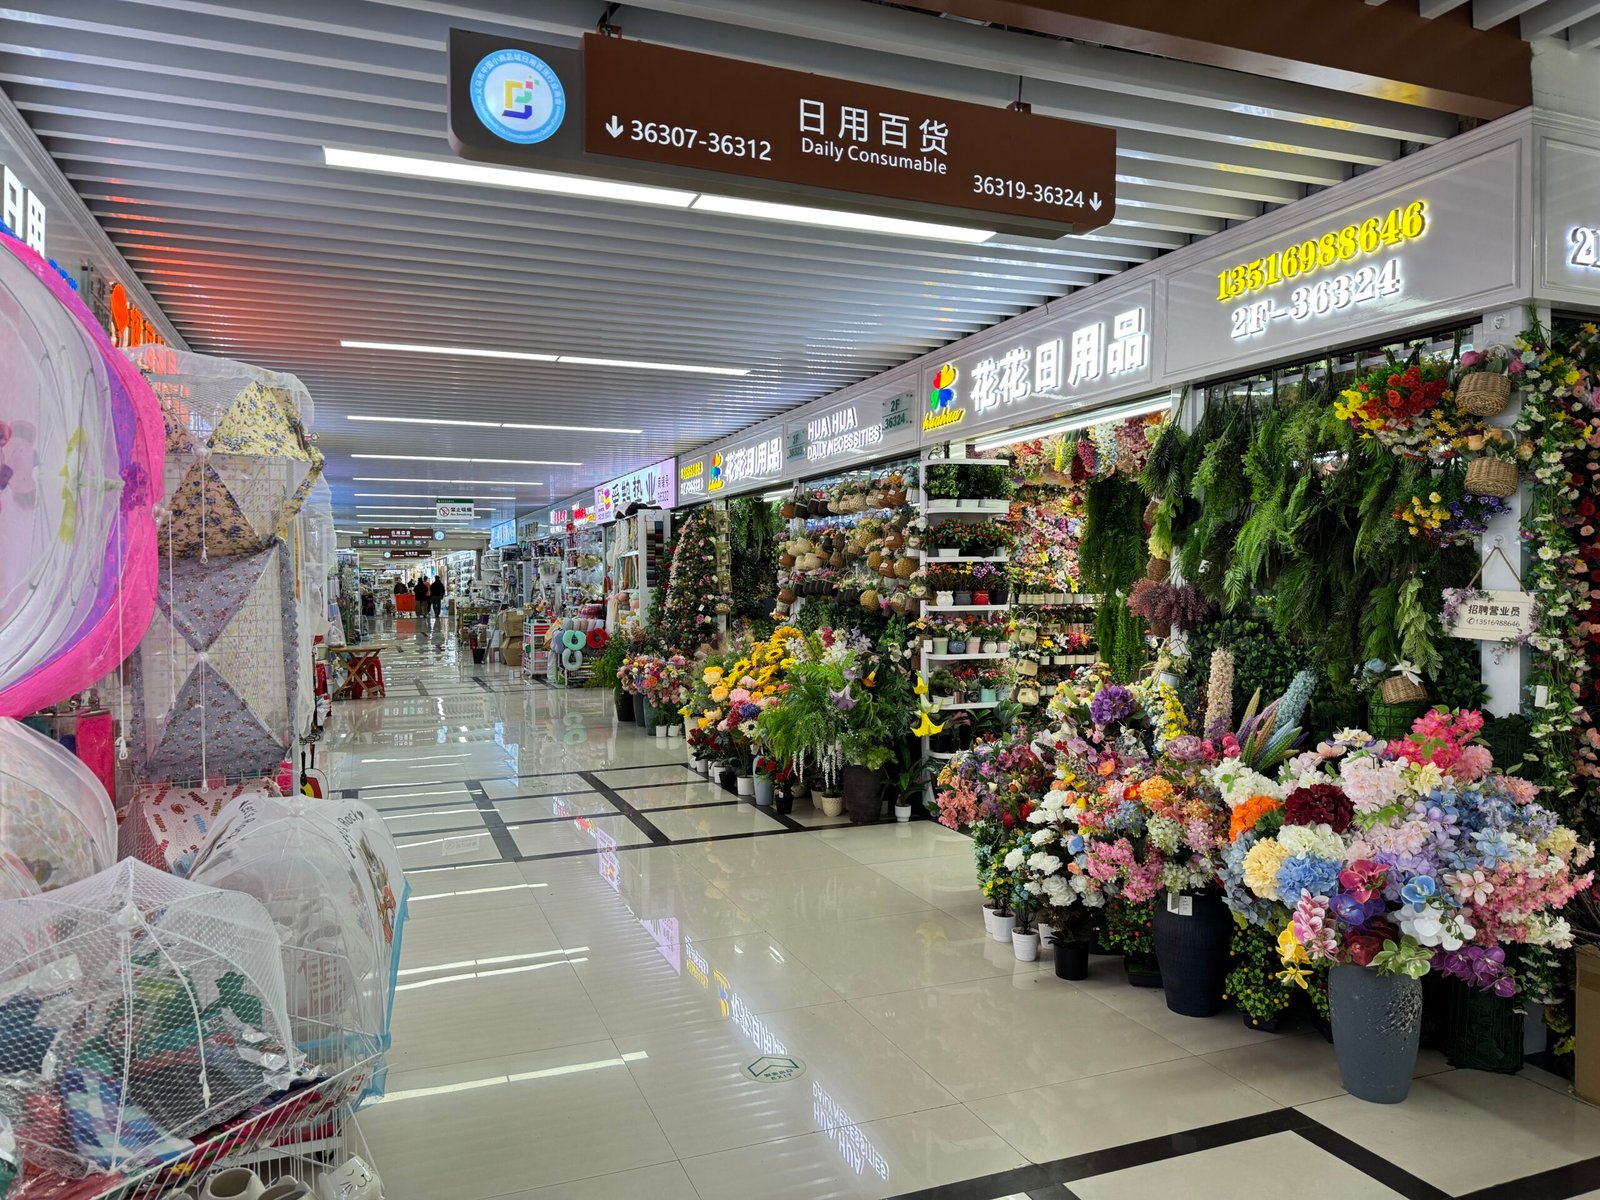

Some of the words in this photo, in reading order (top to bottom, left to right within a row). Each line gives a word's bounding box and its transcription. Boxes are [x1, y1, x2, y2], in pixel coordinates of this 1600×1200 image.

[630, 120, 772, 161] 36307-36312
[800, 98, 949, 156] 日用百货
[801, 137, 844, 163] Daily
[848, 145, 948, 175] Consumable
[973, 174, 1084, 208] 36319-36324
[1215, 199, 1427, 303] 13516988646
[1230, 257, 1402, 339] 2F-36324
[970, 307, 1149, 413] 花花日用品
[807, 416, 831, 442] HUA
[832, 406, 858, 434] HUA
[884, 412, 906, 430] 36324
[890, 399, 900, 412] 2F
[827, 424, 883, 455] NECESSITIES
[725, 436, 783, 482] 花花日用品
[1468, 604, 1521, 618] 招聘营业员
[1476, 617, 1521, 629] 13516988646
